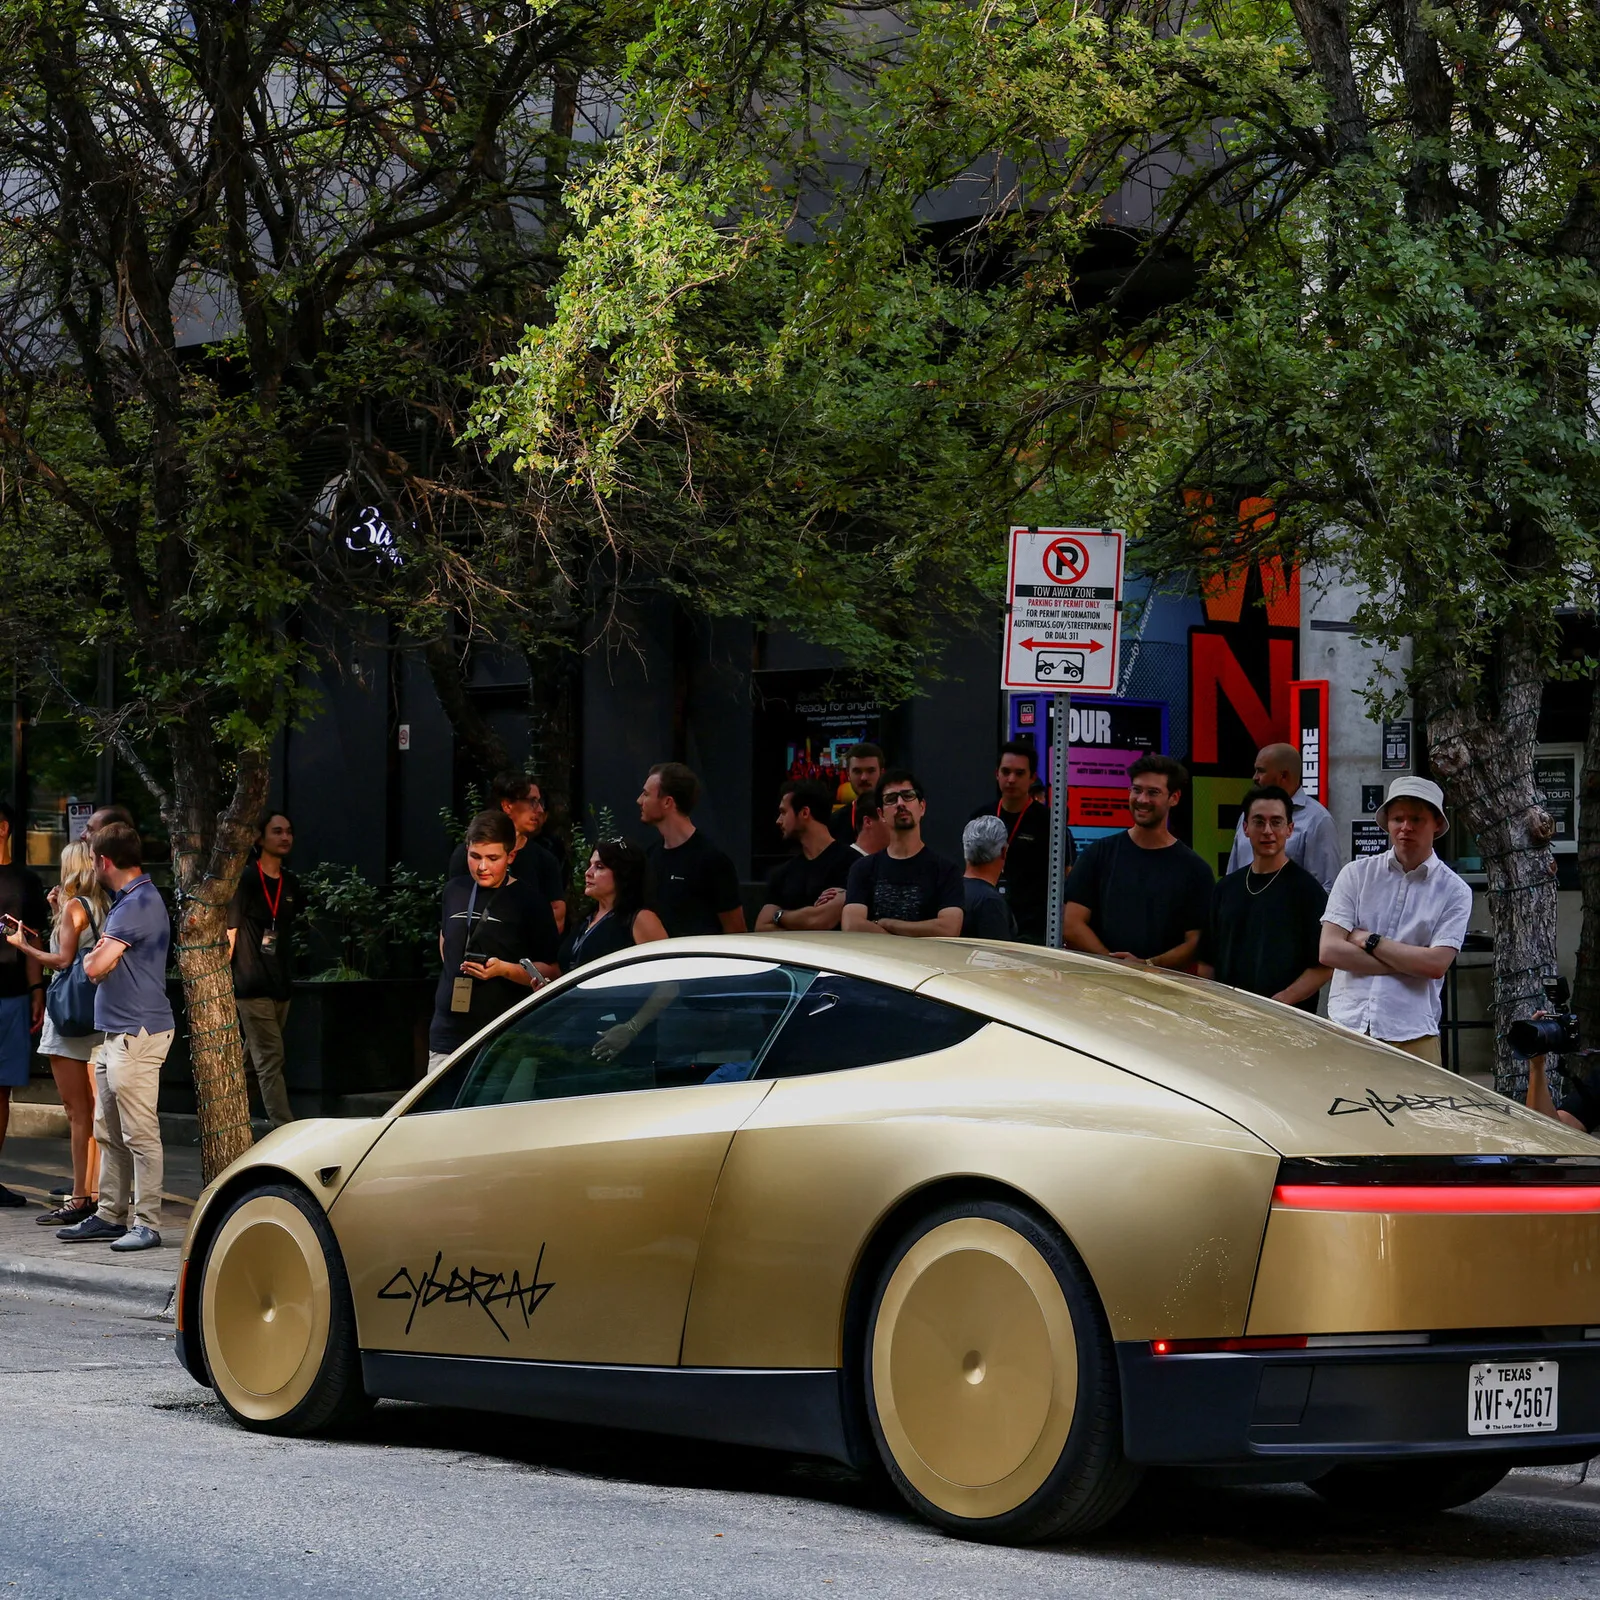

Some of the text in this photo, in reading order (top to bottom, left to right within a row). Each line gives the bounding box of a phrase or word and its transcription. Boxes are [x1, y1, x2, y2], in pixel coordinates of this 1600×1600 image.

[1033, 586, 1096, 599] TOW AWAY ZONE
[1028, 598, 1101, 609] PARKING BY PERMIT ONLY
[1026, 609, 1101, 620] FOR PERMIT INFORMATION
[1013, 619, 1112, 631] AUSTINTEXAS.GOV/STREETPARKING
[1044, 631, 1079, 641] OR DIAL 311
[795, 703, 827, 714] Ready
[829, 701, 845, 712] for
[1302, 728, 1319, 796] HERE
[1546, 791, 1571, 799] TOUR
[1498, 1368, 1532, 1382] TEXAS
